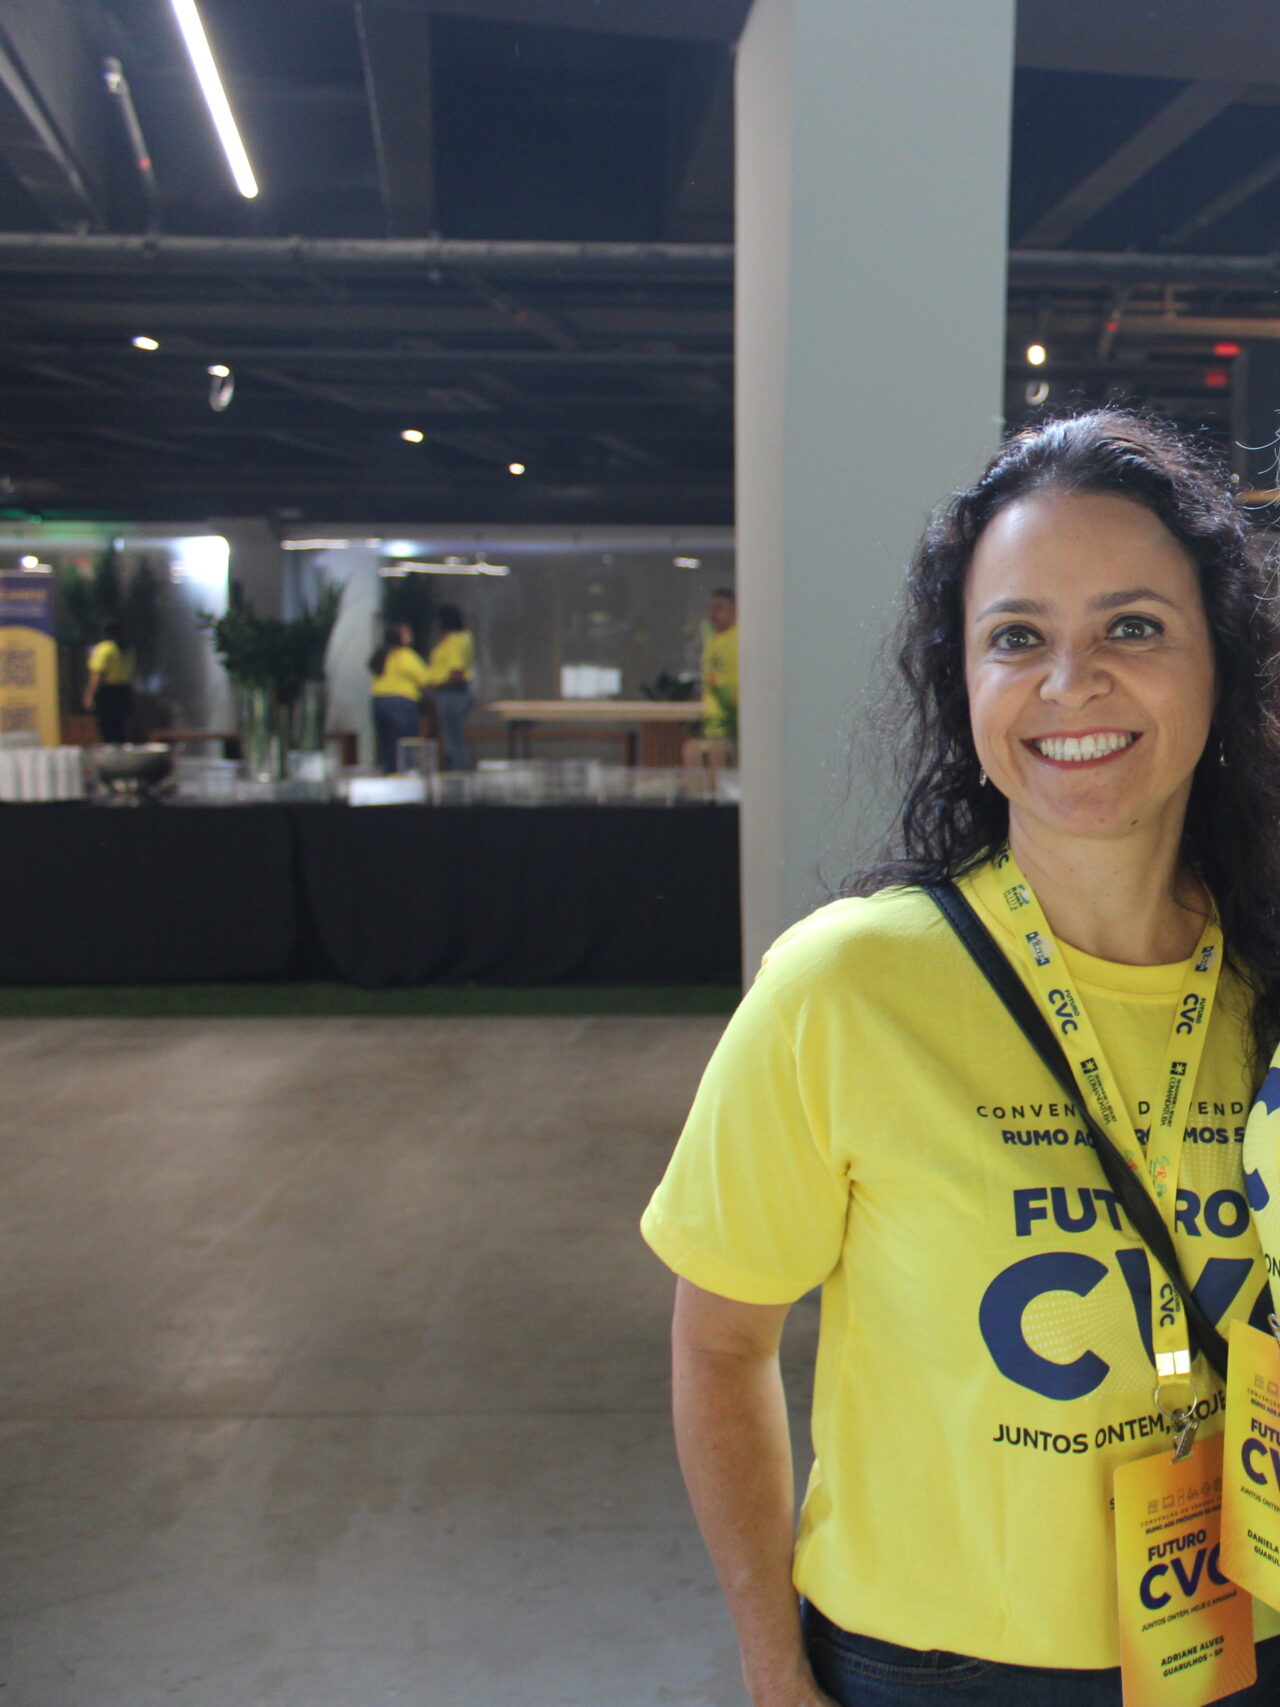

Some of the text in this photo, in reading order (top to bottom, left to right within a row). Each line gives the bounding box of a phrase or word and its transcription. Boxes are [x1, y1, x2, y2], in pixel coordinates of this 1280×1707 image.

[1048, 989, 1078, 1035] CVC
[1064, 989, 1080, 1016] FUTURO
[1176, 993, 1200, 1035] CVC
[976, 1103, 1076, 1119] CONVEN
[1002, 1128, 1069, 1146] RUMO
[1013, 1187, 1250, 1238] FUTRO
[1160, 1283, 1176, 1328] CVC
[993, 1424, 1089, 1454] JUNTOS
[1095, 1412, 1171, 1448] ONTEM,
[1240, 1486, 1262, 1503] JUNTOS
[1148, 1529, 1208, 1562] FUTURO
[1247, 1529, 1280, 1554] DANIELA
[1141, 1617, 1166, 1633] JUNTOS
[1161, 1635, 1225, 1667] ADRIANE ALVES
[1163, 1654, 1208, 1678] GUARULHOS
[1213, 1647, 1225, 1658] SP
